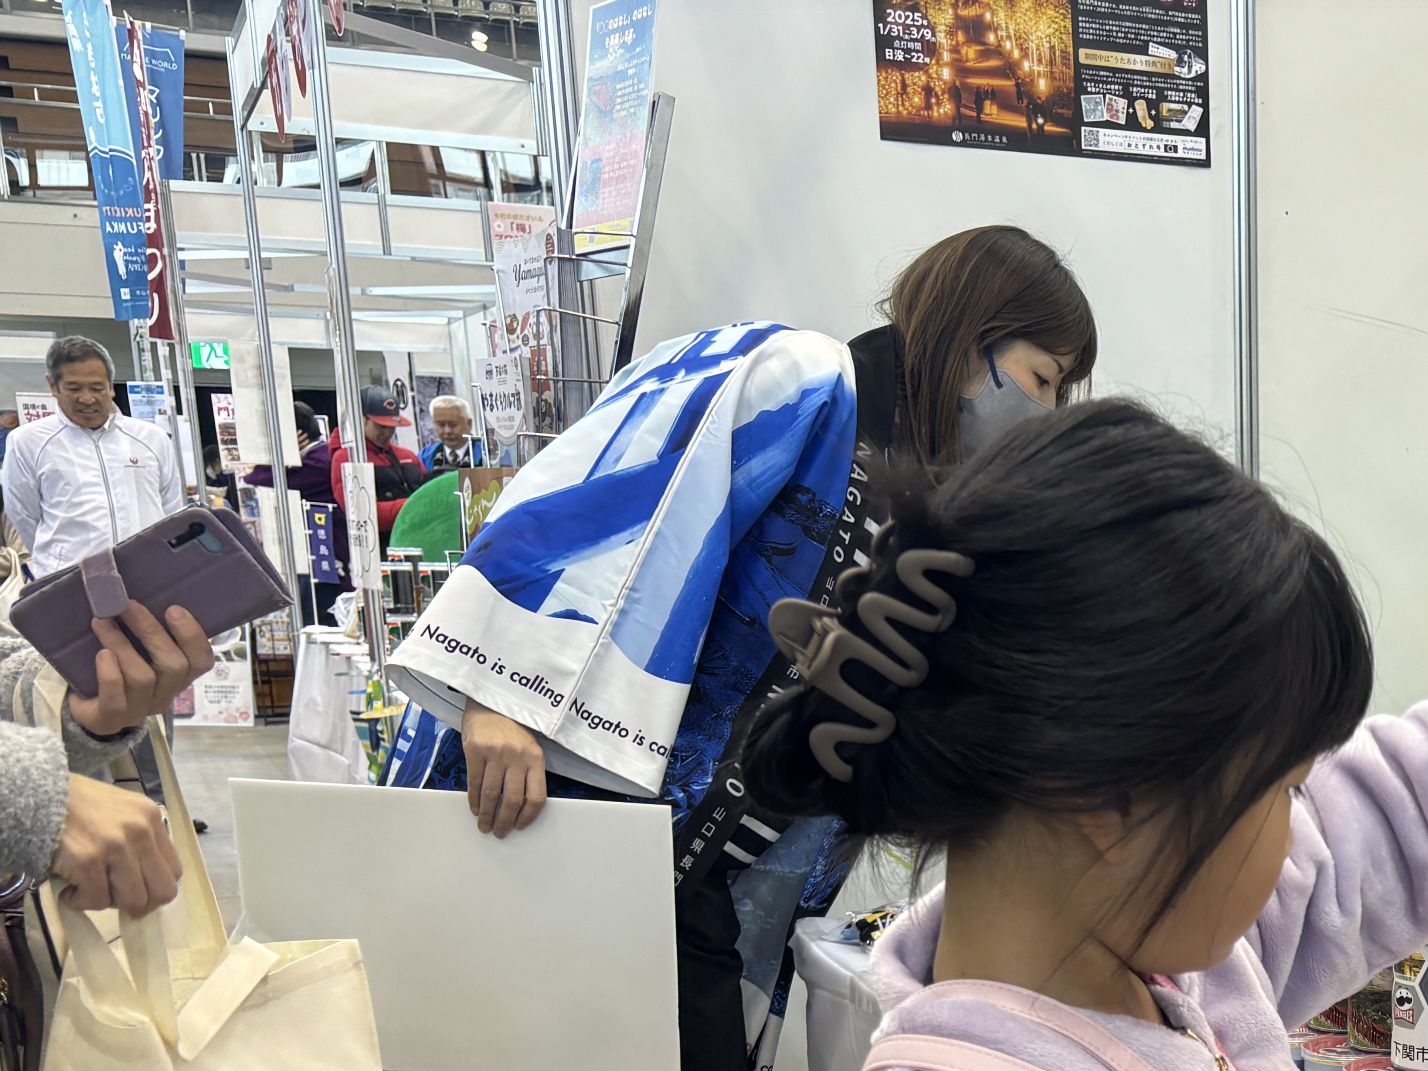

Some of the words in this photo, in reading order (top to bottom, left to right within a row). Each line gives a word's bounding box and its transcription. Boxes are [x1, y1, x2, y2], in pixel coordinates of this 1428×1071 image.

[150, 59, 178, 71] WORLD
[832, 440, 873, 563] NAGATO
[420, 623, 487, 666] Nagato
[490, 657, 506, 676] is
[509, 669, 565, 708] calling
[569, 696, 630, 739] Nagato
[632, 729, 646, 746] is
